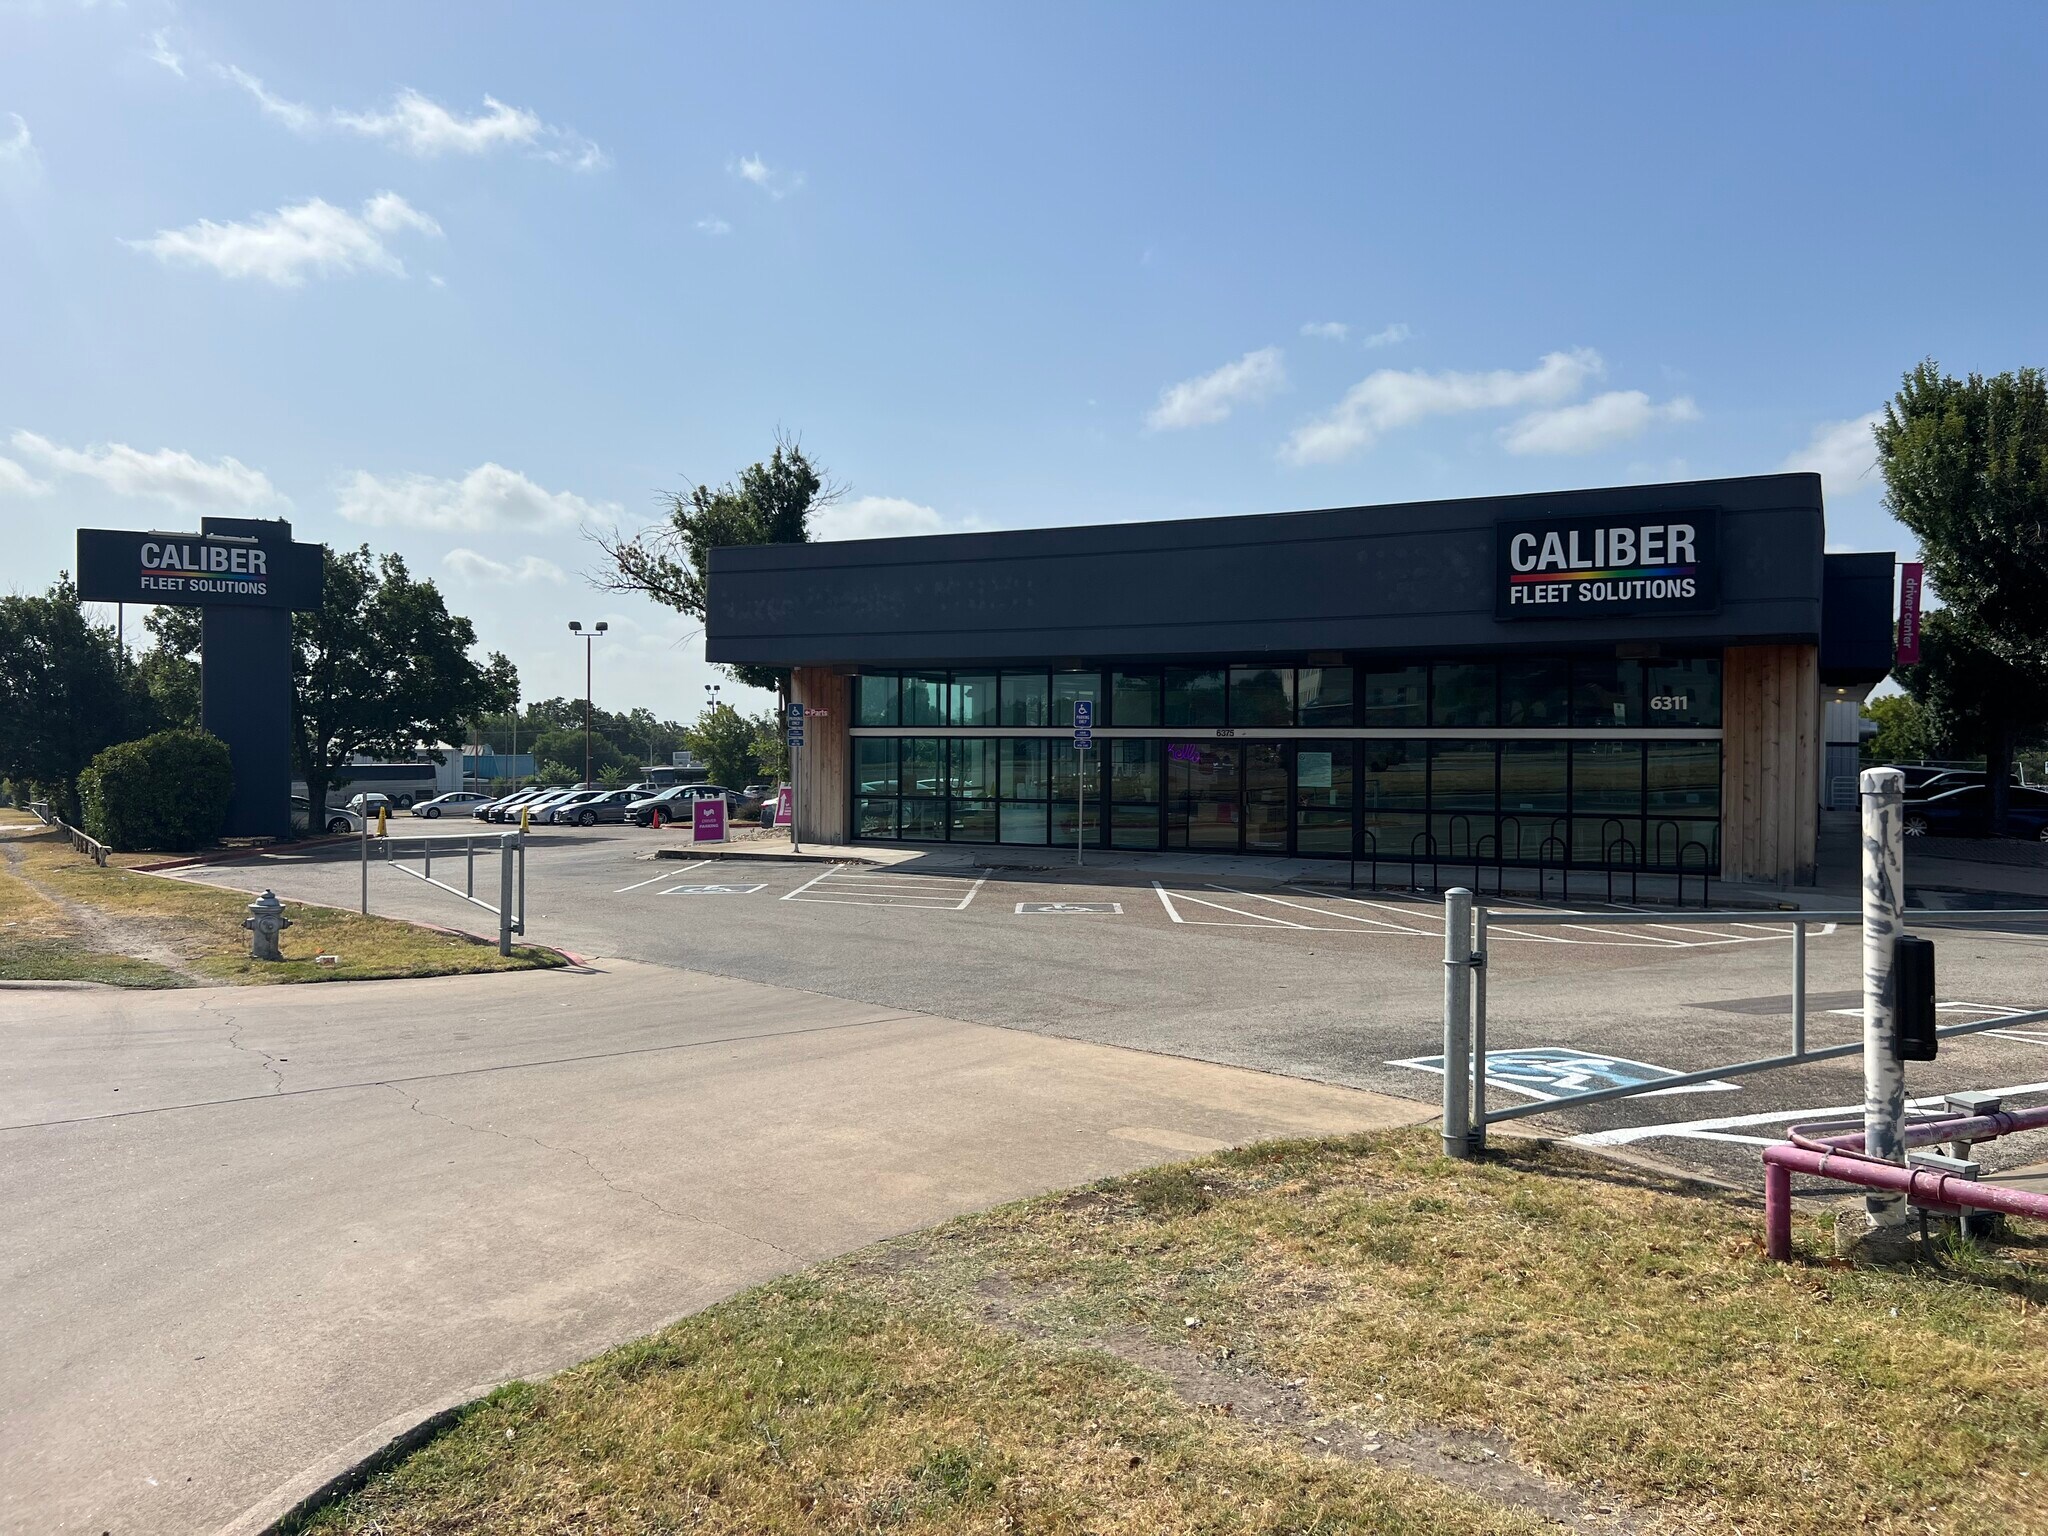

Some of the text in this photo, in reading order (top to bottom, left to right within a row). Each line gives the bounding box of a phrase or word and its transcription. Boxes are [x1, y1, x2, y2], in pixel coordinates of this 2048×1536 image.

[140, 542, 267, 575] CALIBER
[1510, 524, 1697, 572] CALIBER
[140, 576, 267, 596] FLEET SOLUTIONS
[1510, 578, 1696, 604] FLEET SOLUTIONS
[1903, 578, 1918, 649] driver center
[811, 709, 828, 717] Parts
[1650, 696, 1687, 710] 6311
[1216, 729, 1235, 737] 6375
